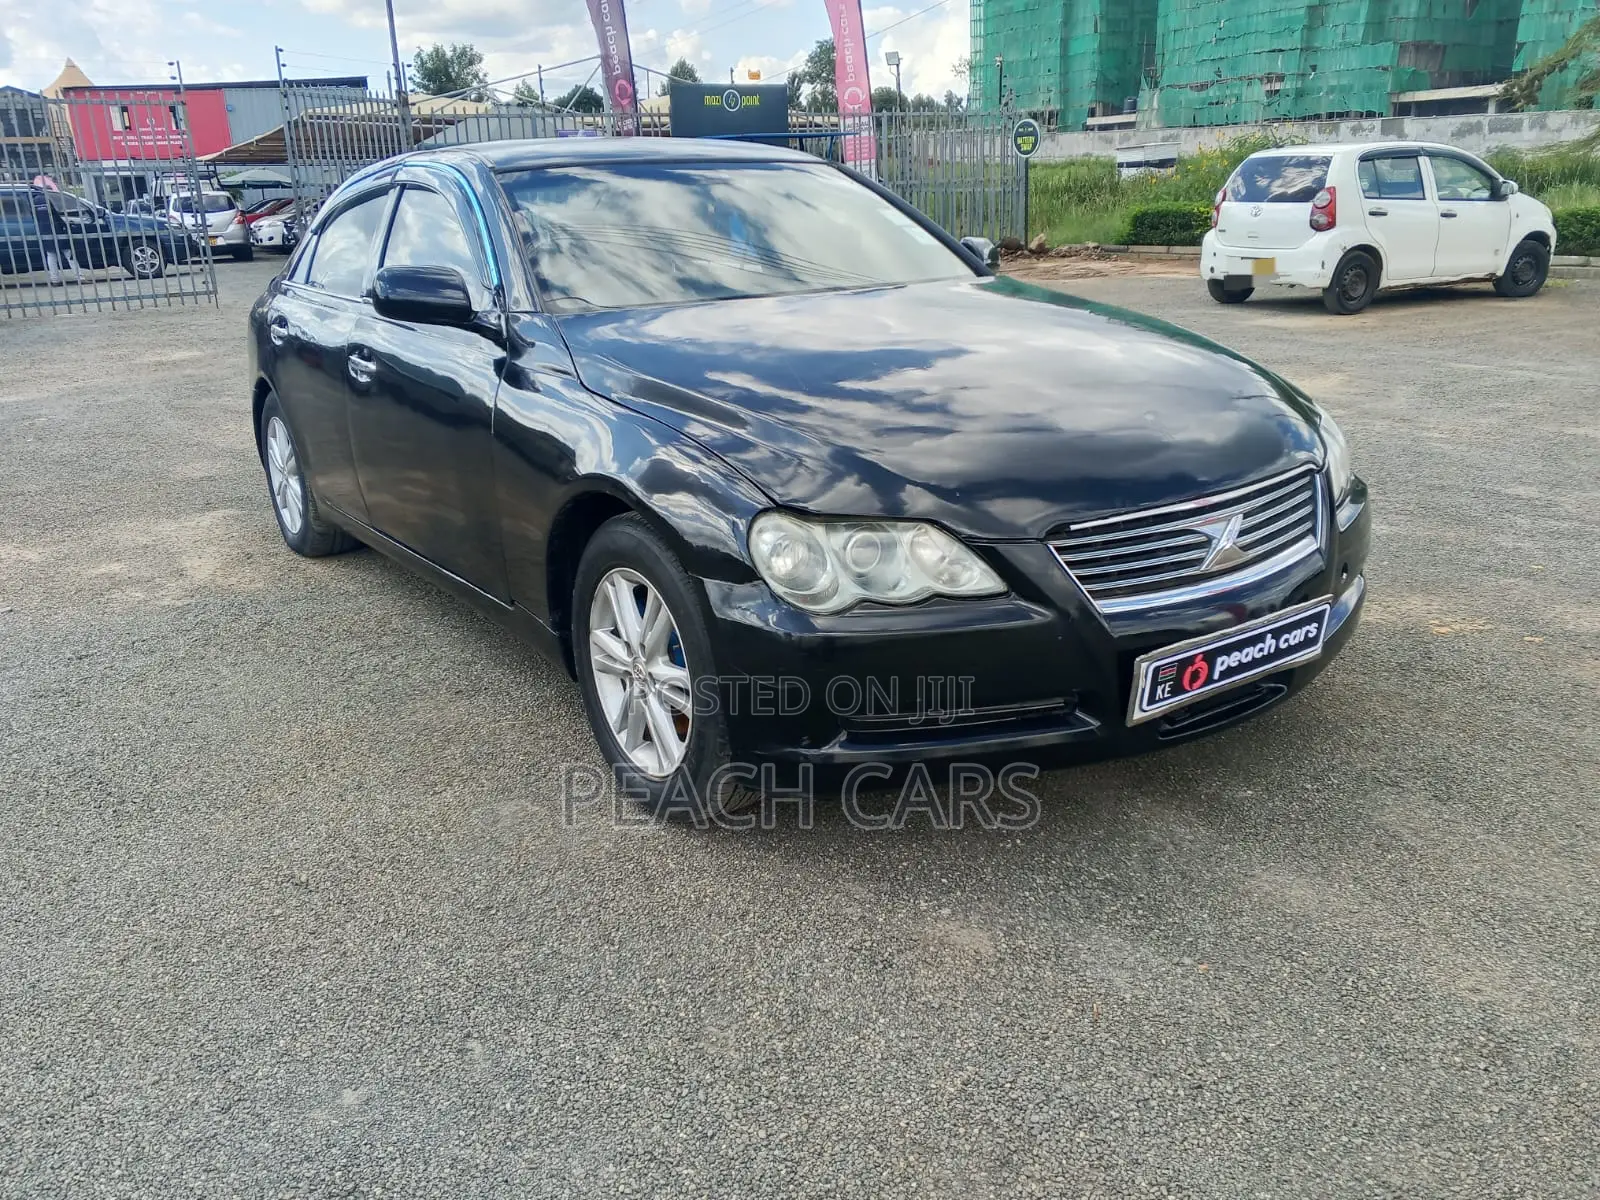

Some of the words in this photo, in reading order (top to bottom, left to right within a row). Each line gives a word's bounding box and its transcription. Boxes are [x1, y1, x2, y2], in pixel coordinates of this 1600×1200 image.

[704, 95, 721, 105] mazi
[741, 93, 760, 108] point
[1212, 633, 1277, 680] peach
[1279, 621, 1319, 650] cars
[1155, 681, 1173, 701] KE
